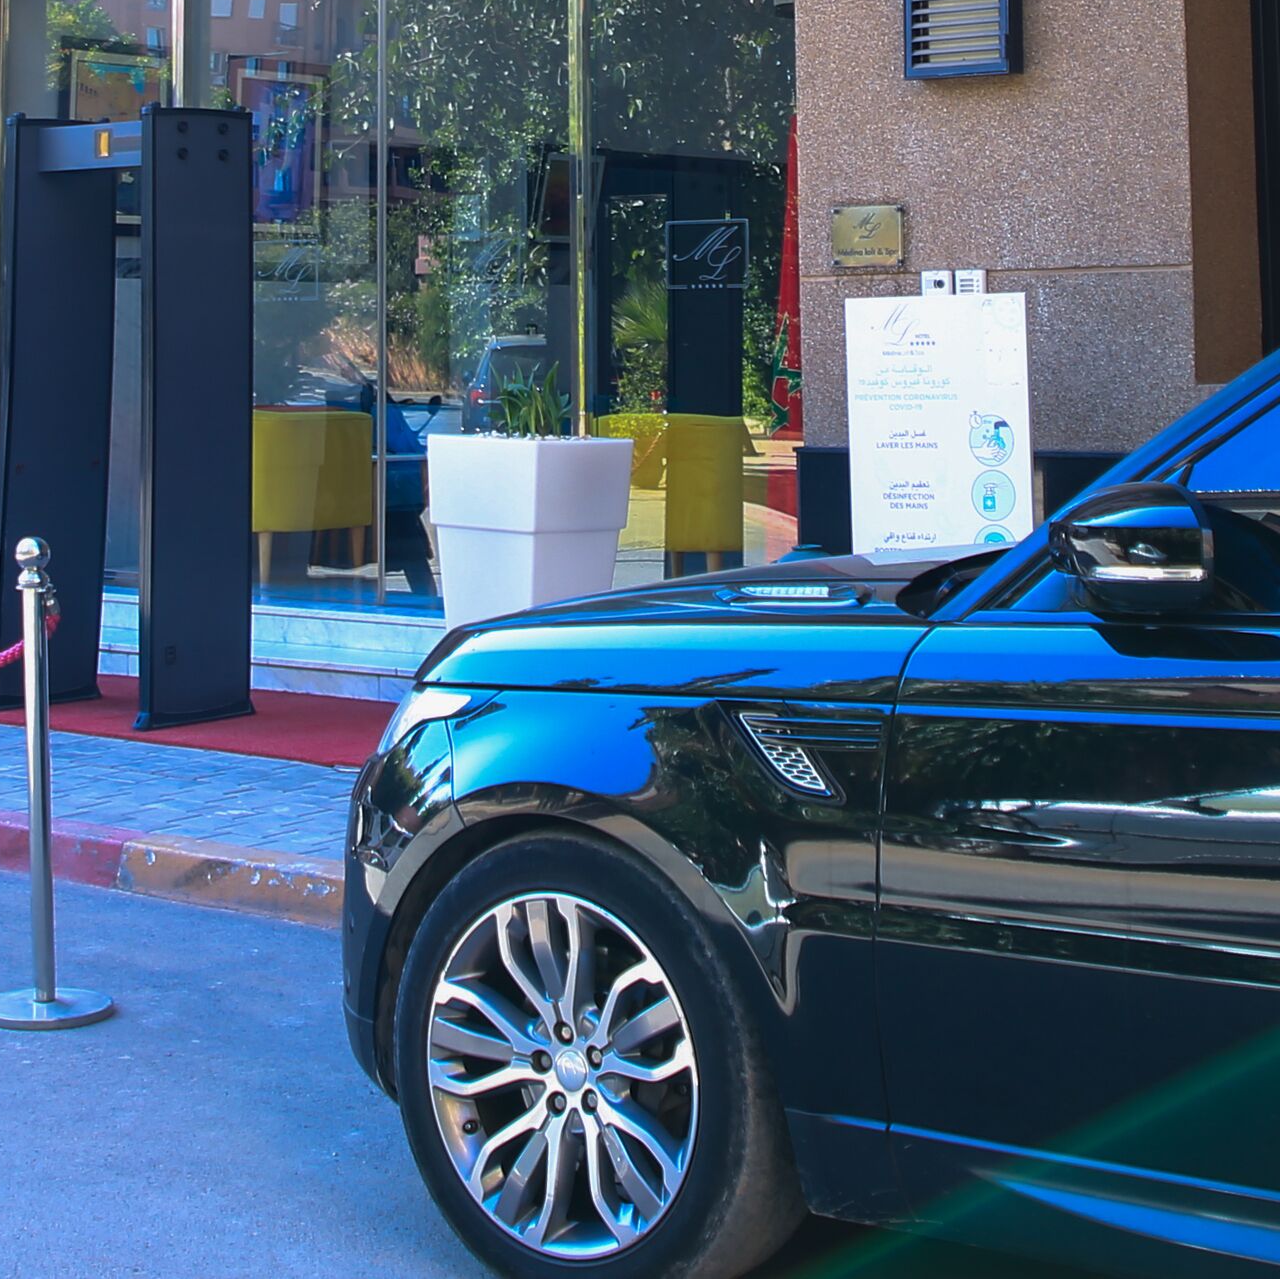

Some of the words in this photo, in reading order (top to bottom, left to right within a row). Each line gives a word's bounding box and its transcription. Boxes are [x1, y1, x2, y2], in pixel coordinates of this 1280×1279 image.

[904, 393, 958, 401] CORONAVIRUS
[915, 441, 938, 449] MAINS
[890, 502, 904, 510] DES
[905, 502, 929, 510] MAINS
